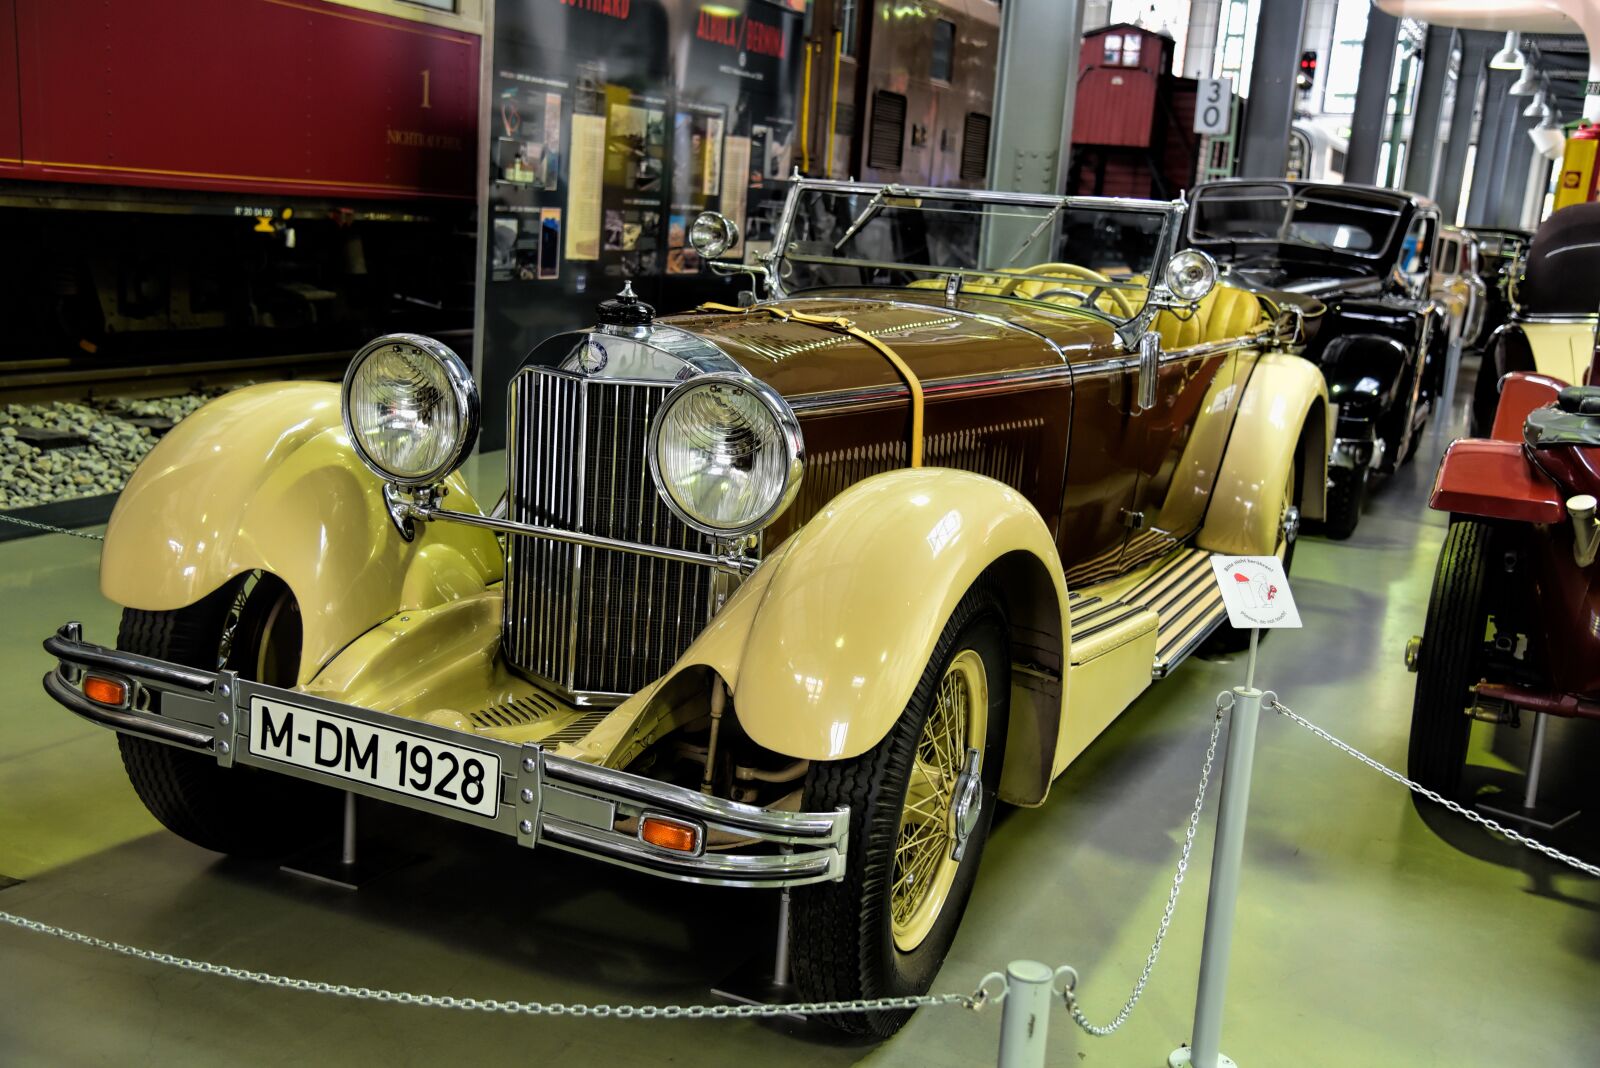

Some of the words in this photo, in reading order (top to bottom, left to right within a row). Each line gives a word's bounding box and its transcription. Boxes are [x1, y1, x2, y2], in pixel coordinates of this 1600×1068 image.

[420, 69, 432, 109] 1
[260, 706, 379, 780] M-DM
[395, 740, 485, 805] 1928
